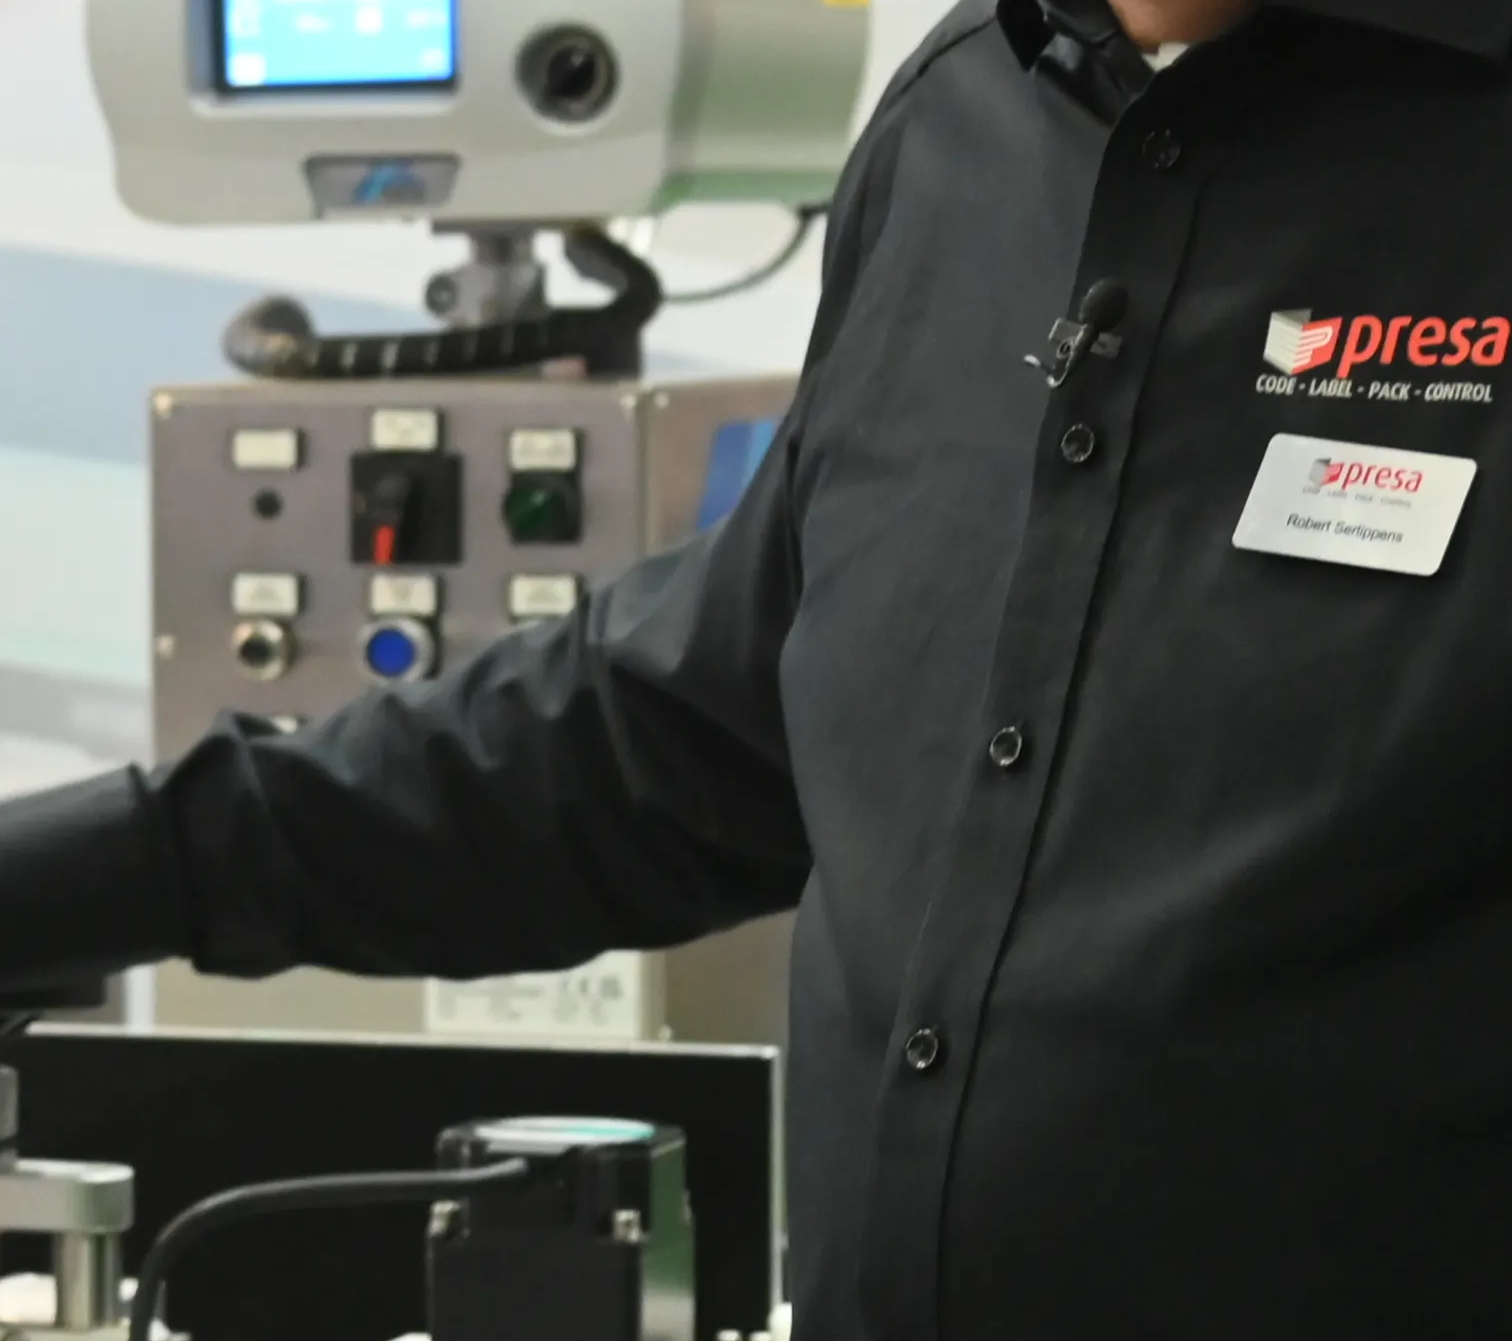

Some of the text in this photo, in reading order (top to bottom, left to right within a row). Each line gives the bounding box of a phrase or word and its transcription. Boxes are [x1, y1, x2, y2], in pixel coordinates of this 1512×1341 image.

[1335, 314, 1511, 378] presa
[1256, 374, 1493, 403] CODE LABEL PACK CONTROL
[1342, 461, 1423, 493] presa
[1286, 513, 1332, 533] Robert
